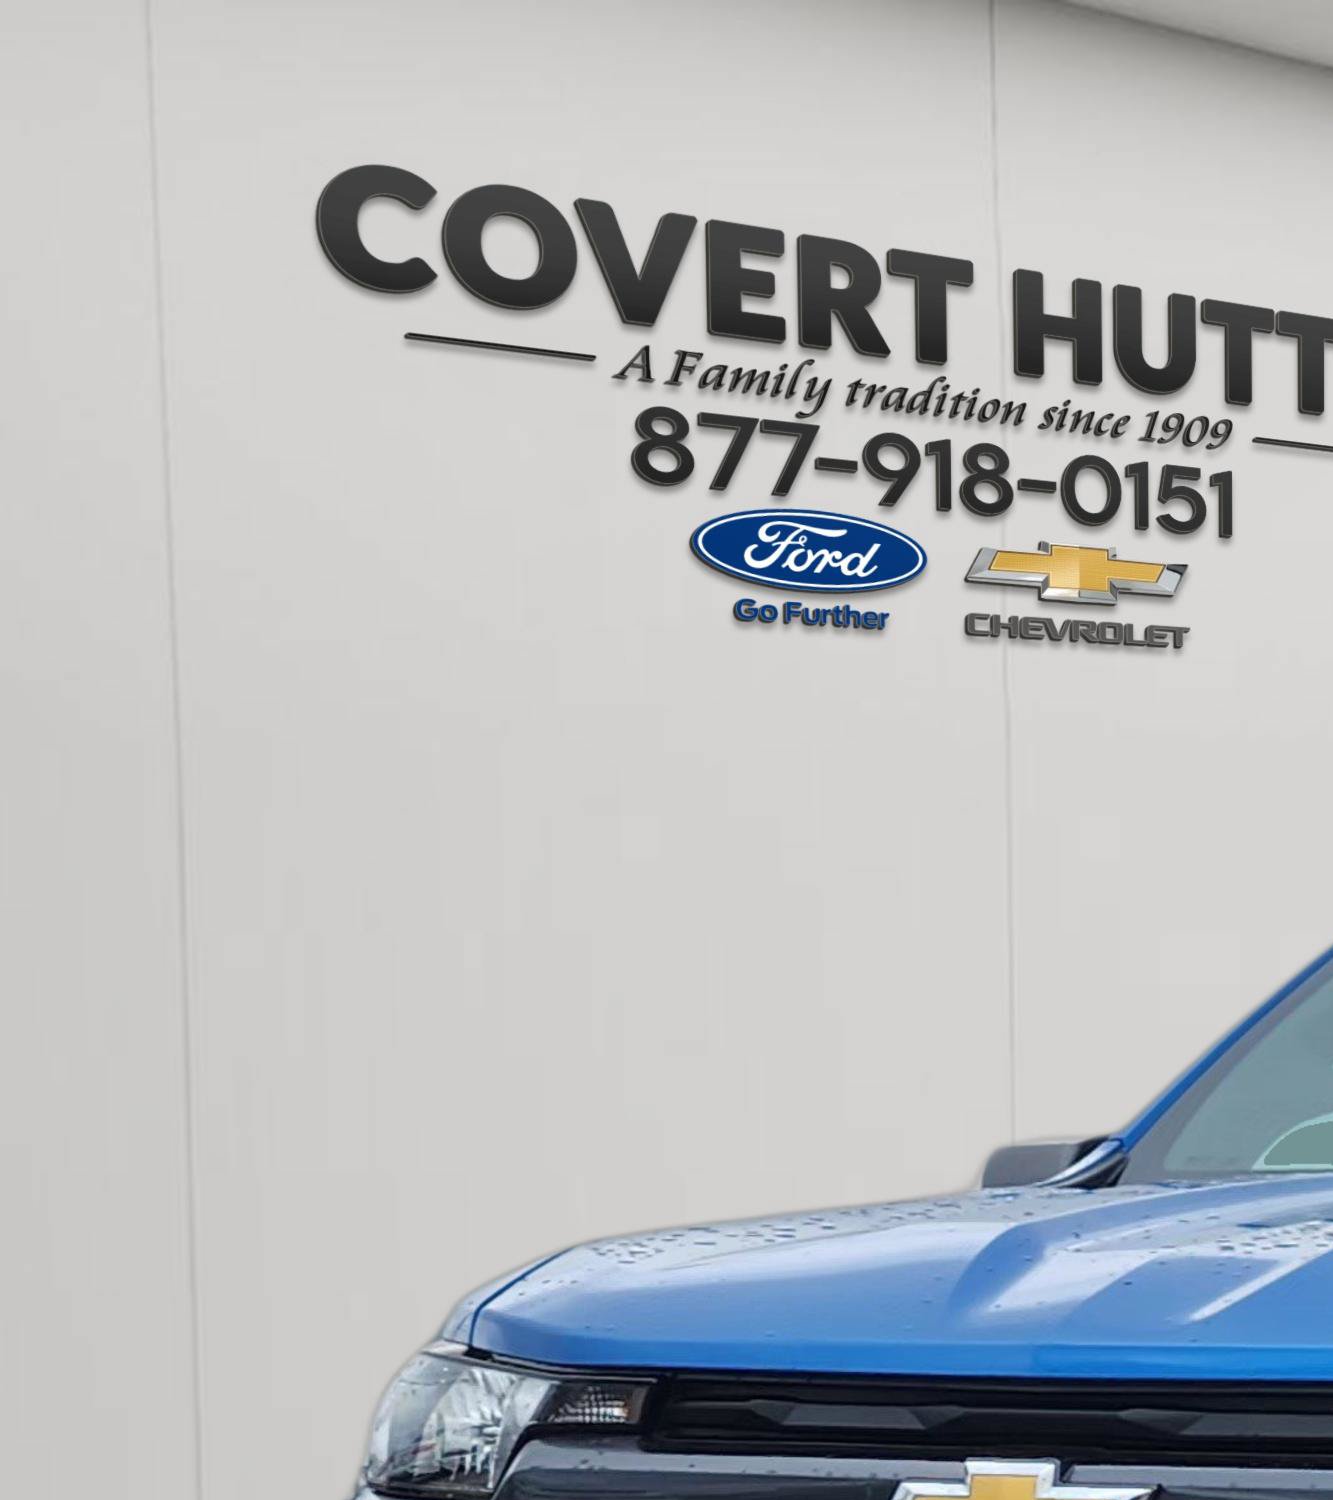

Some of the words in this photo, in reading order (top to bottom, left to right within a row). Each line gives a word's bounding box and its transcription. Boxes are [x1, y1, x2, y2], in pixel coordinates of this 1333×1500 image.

[315, 164, 975, 367] COVERT
[612, 344, 656, 384] A
[663, 348, 833, 420] Family
[845, 374, 1028, 428] tradition
[1037, 400, 1131, 439] since
[1138, 409, 1234, 450] 1909
[630, 405, 1234, 540] 877-918-0151
[743, 520, 878, 581] Ford
[732, 598, 779, 628] Go
[782, 600, 891, 632] Further
[963, 612, 1191, 650] CHEVROLET
